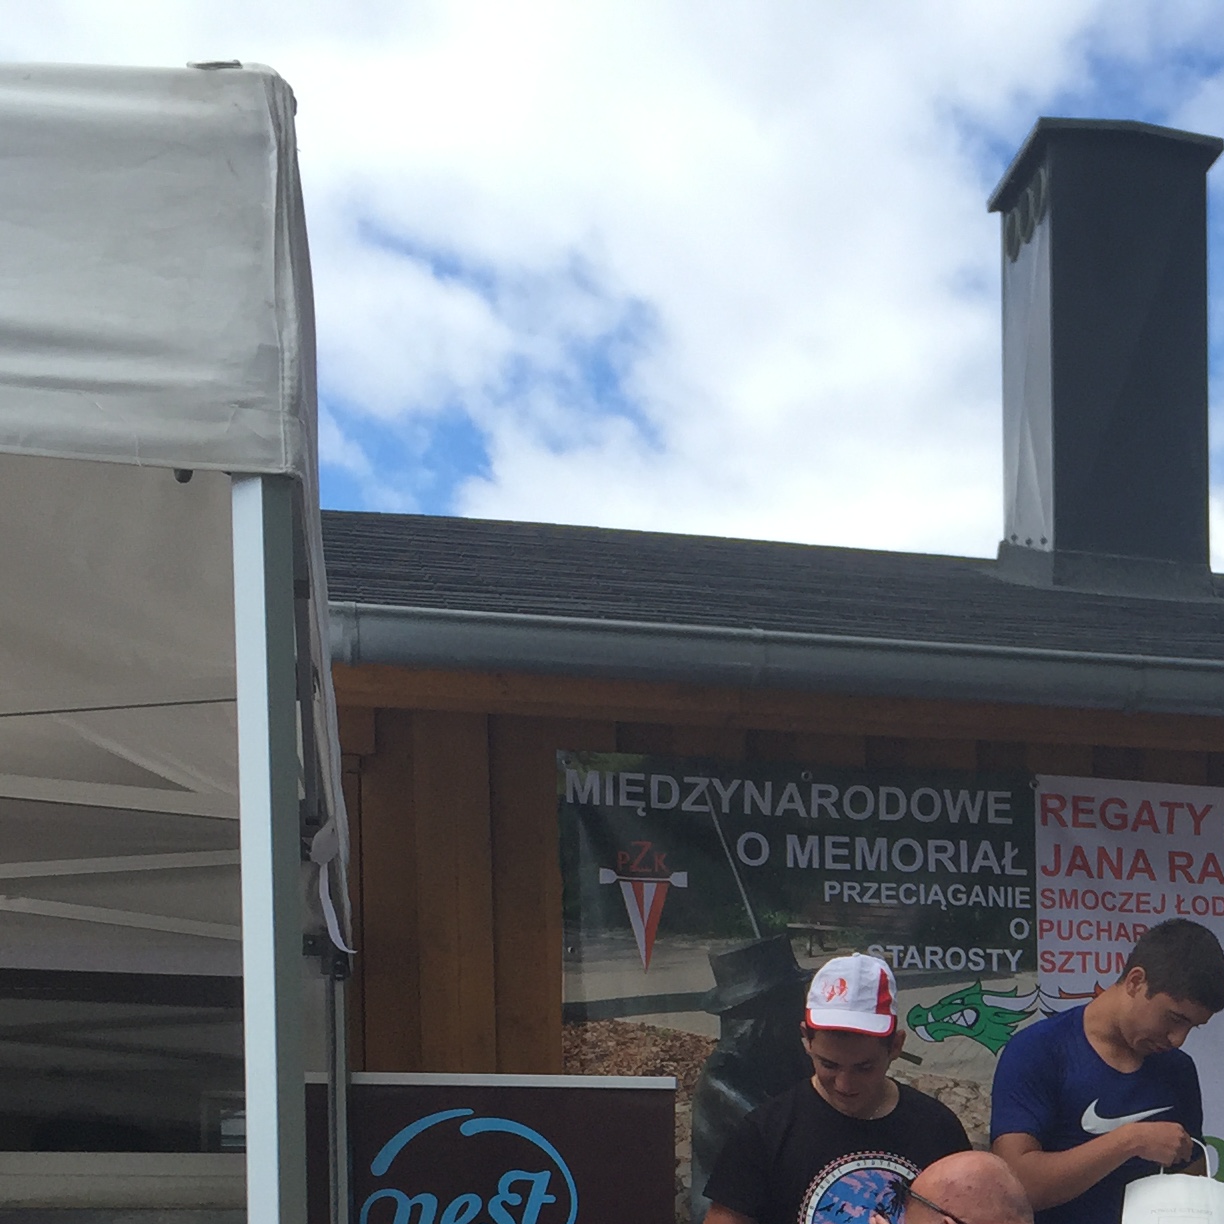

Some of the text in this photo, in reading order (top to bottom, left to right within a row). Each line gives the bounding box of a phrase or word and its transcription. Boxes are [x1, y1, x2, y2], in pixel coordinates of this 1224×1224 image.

[565, 769, 1013, 825] MIĘDZYNARODOWE
[1040, 793, 1215, 836] REGATY
[617, 841, 669, 873] PZK
[736, 831, 770, 866] O
[786, 834, 1028, 877] MEMORIAŁ
[1040, 843, 1157, 882] JANA
[824, 881, 1031, 912] PRZECIĄGANIE
[1040, 887, 1168, 915] SMOCZEJ
[1010, 917, 1030, 940] O
